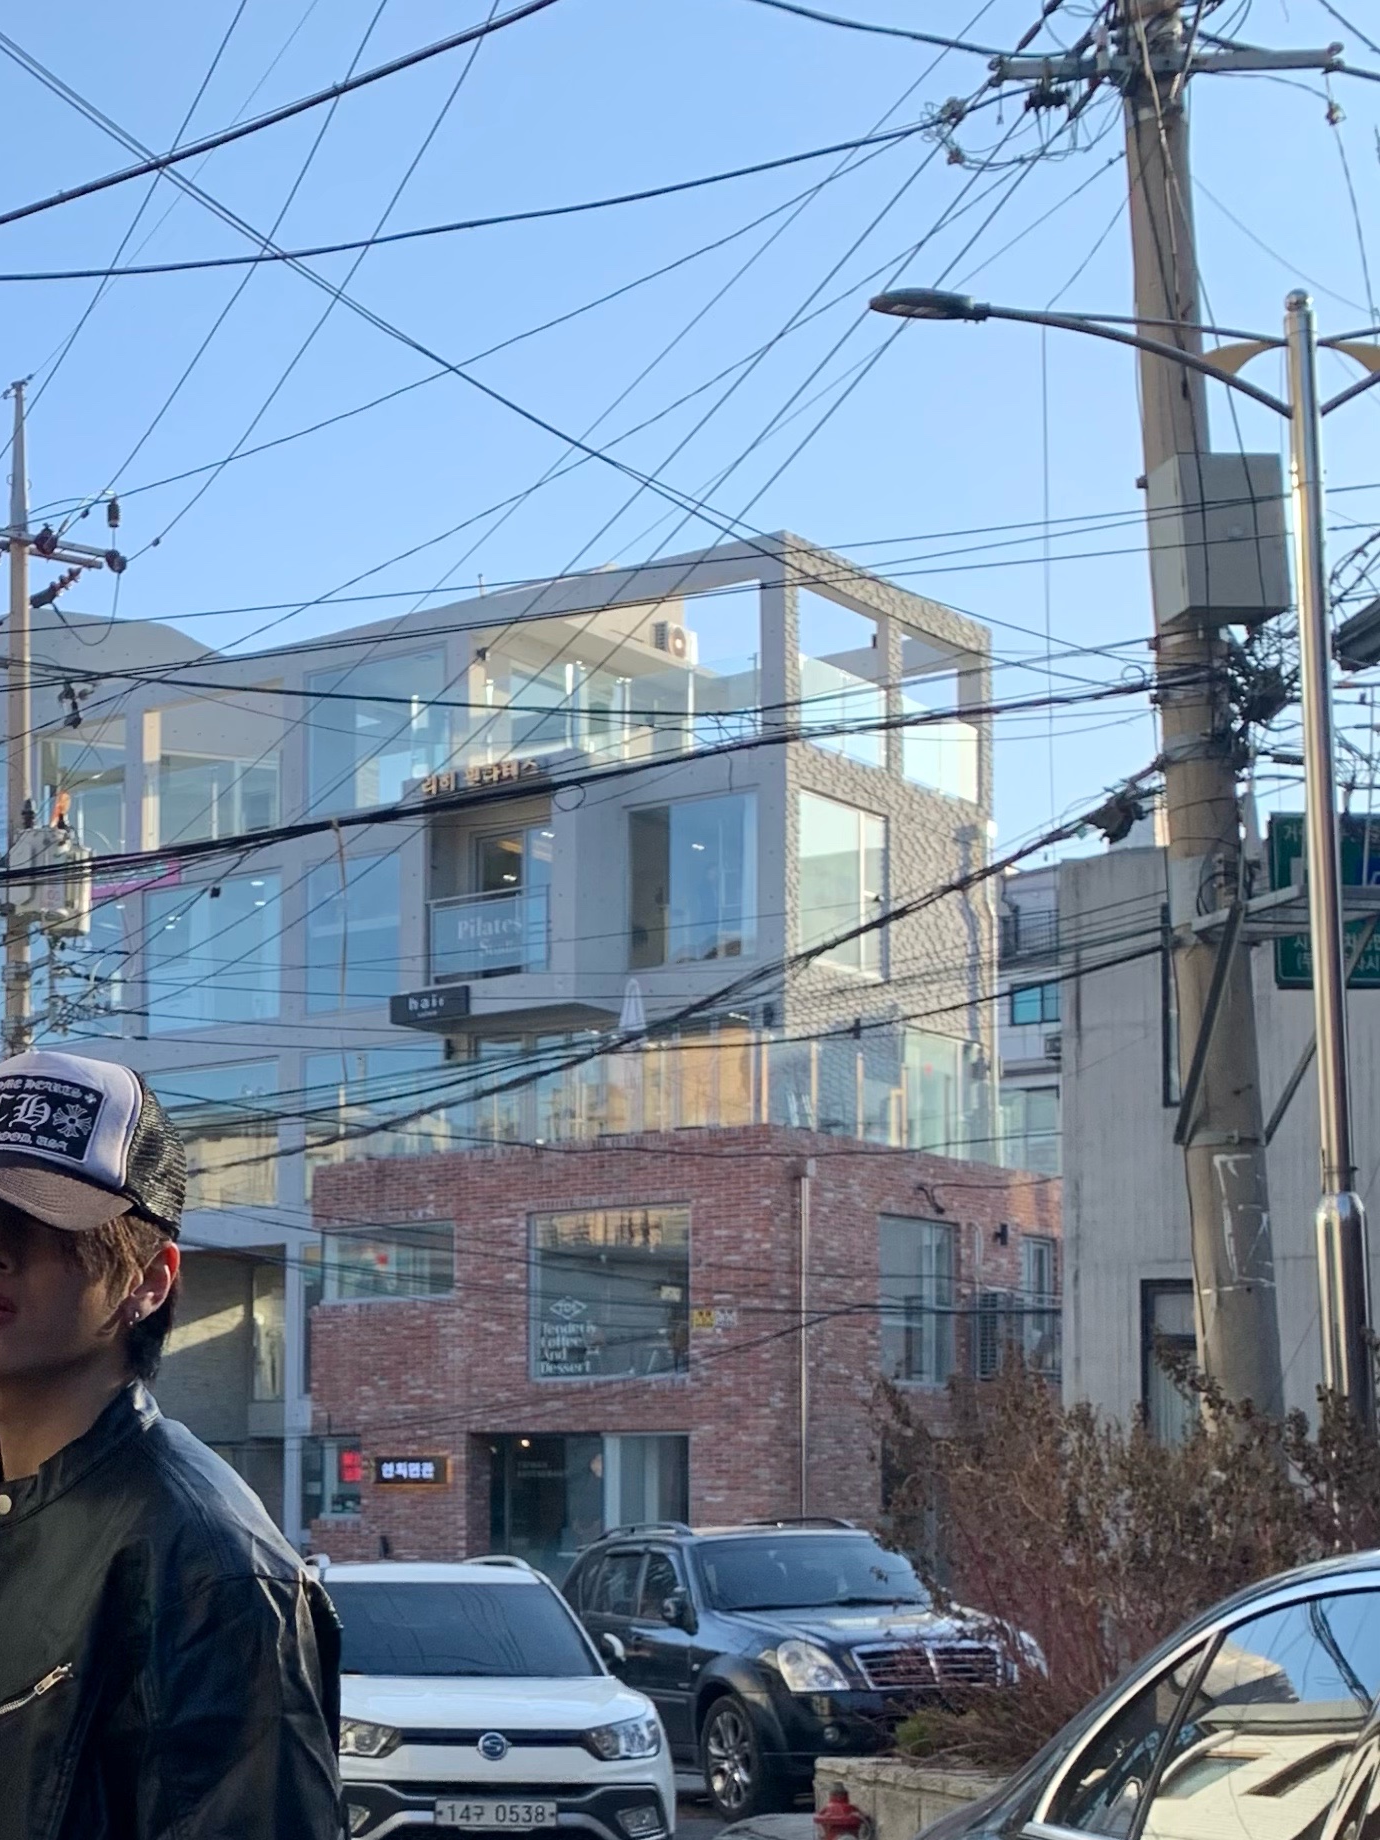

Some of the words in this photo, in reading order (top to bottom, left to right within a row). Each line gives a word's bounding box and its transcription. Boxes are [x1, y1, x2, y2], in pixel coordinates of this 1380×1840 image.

[458, 916, 523, 940] Pilates
[24, 1078, 83, 1099] HEARTS
[36, 1135, 69, 1152] USA
[447, 1803, 485, 1823] 14구
[495, 1803, 546, 1823] 0538
